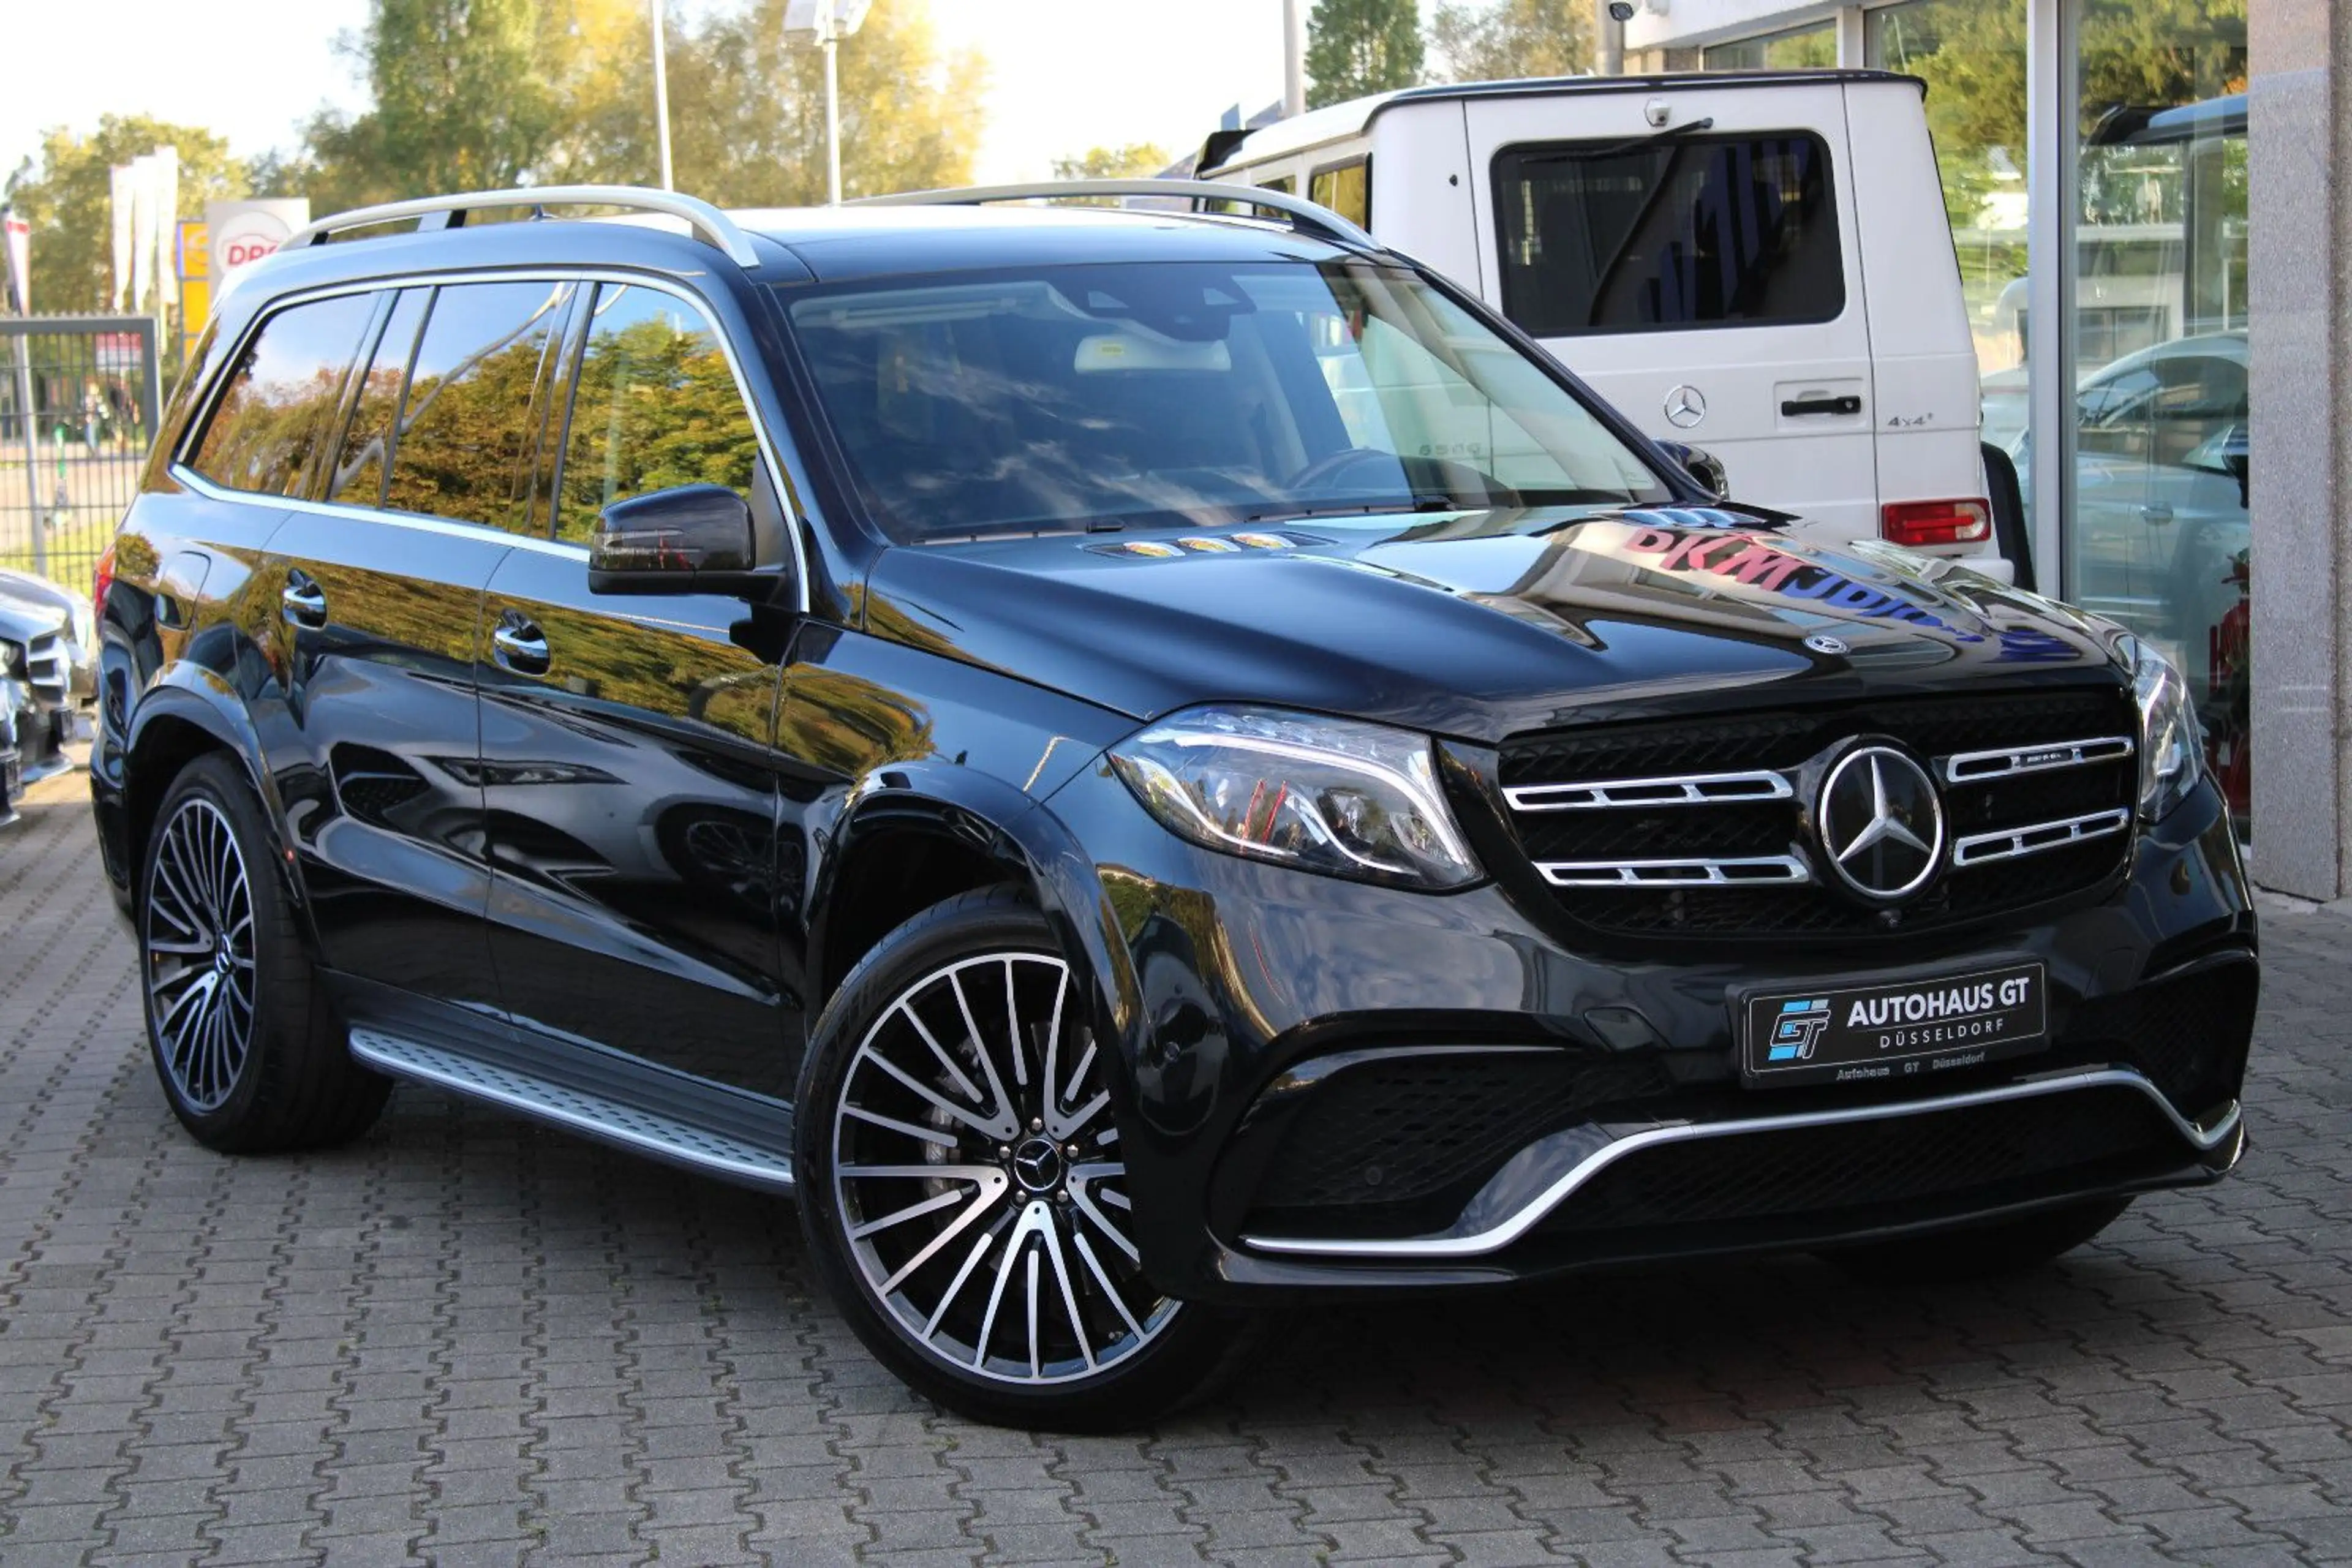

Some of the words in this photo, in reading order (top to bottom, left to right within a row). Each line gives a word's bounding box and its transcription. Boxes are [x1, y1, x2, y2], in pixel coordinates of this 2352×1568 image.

[1846, 983, 1994, 1027] AUTOHAUS
[1999, 977, 2029, 1006] GT
[1880, 1018, 2005, 1049] DÜSSELDORF
[1836, 1065, 1890, 1082] Autohaus
[1904, 1061, 1920, 1074] GT
[1932, 1051, 1985, 1071] Düsseldorf
